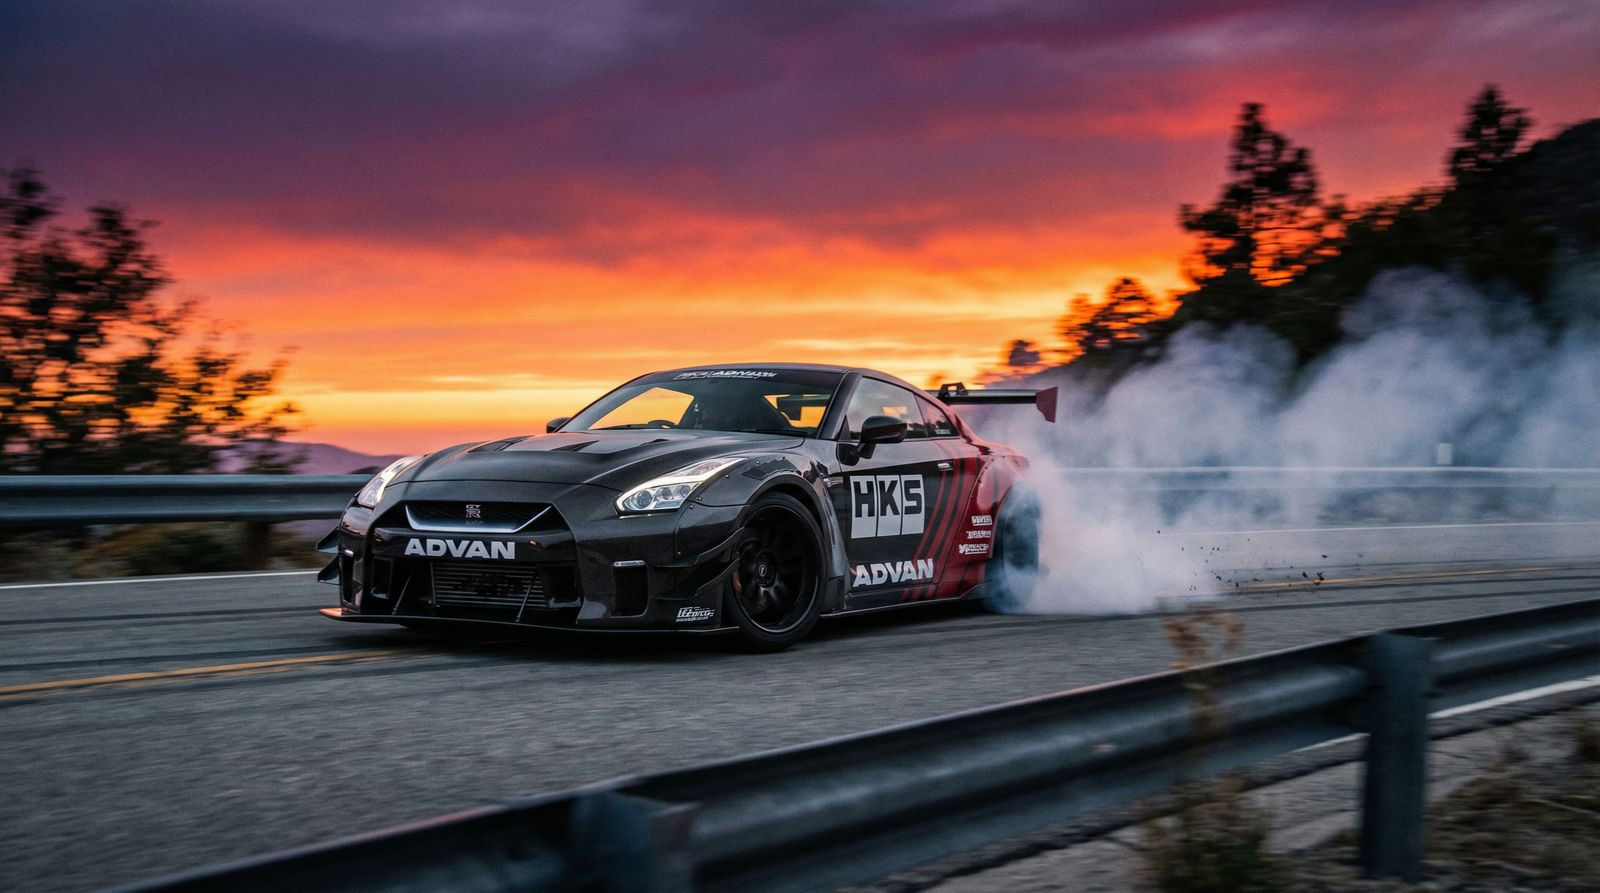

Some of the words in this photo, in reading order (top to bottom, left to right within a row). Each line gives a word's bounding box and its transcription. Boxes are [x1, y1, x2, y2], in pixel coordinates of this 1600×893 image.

[852, 479, 923, 518] HKS
[404, 538, 516, 559] ADVAN
[852, 558, 934, 587] ADVAN
